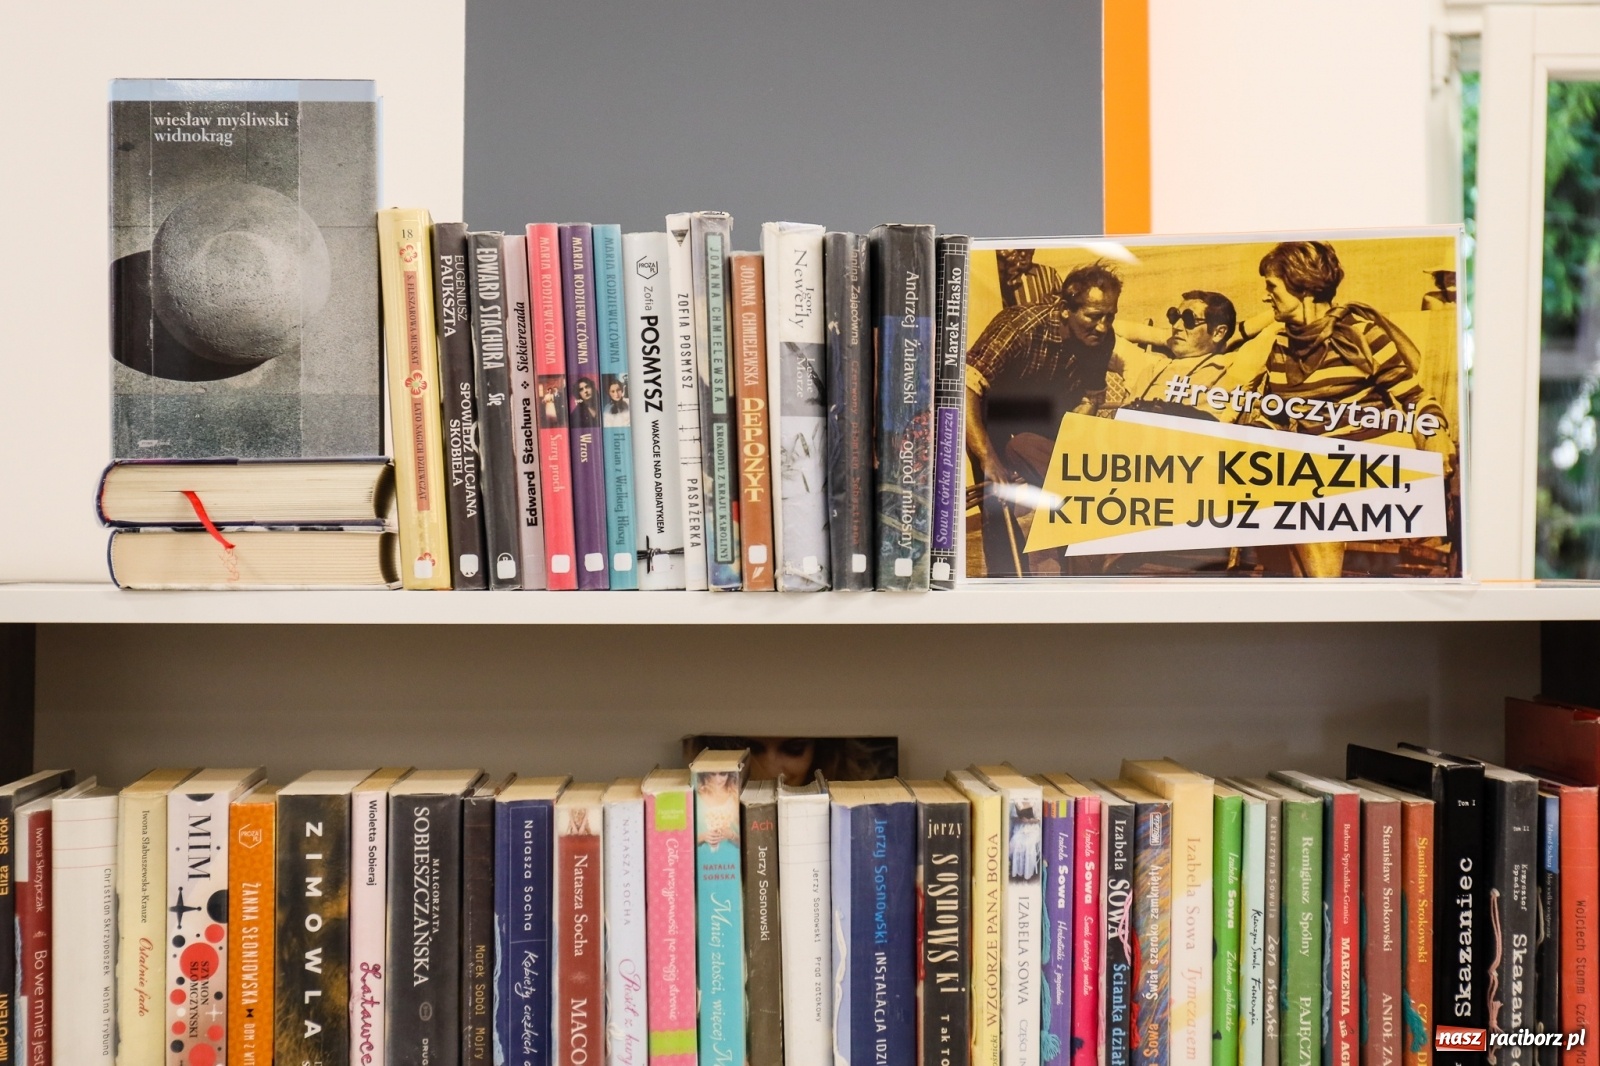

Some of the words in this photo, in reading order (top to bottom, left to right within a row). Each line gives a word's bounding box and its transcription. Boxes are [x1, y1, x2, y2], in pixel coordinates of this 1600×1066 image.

[154, 112, 212, 126] wiesław
[217, 112, 289, 131] myśliwski
[154, 128, 233, 147] widnokrąg
[475, 248, 503, 301] EDWARD
[539, 237, 552, 269] MARIA
[573, 237, 585, 269] MARIA
[605, 237, 616, 269] MARIA
[709, 247, 723, 299] JOANNA
[440, 255, 456, 337] PAUKSZTA
[454, 255, 467, 321] EUGENIUSZ
[643, 285, 655, 311] Zofia
[740, 264, 756, 307] JOANNA
[789, 250, 807, 328] Newerly
[803, 287, 815, 314] Igor
[902, 271, 920, 328] Andrzej
[947, 267, 962, 316] Hłasko
[407, 283, 419, 365] FLESZAROWA-MUSKAT
[541, 274, 557, 365] RODZIEWICZÓWNA
[575, 274, 589, 365] RODZIEWICZÓWNA
[606, 274, 620, 364] RODZIEWICZÓWNA
[678, 293, 690, 331] ZOFIA
[848, 285, 861, 346] Zającówna
[479, 305, 505, 369] STACHURA
[514, 301, 530, 373] Siekierezada
[711, 307, 726, 403] CHMIELEWSKA
[741, 312, 759, 386] CHMIELEWSKA
[945, 321, 959, 367] Marek
[640, 315, 663, 413] POSMYSZ
[679, 335, 693, 389] POSMYSZ
[796, 357, 807, 398] Morze
[806, 357, 816, 393] Leśne
[902, 338, 922, 404] Żuławski
[413, 403, 423, 421] LATO
[1165, 374, 1441, 436] #retroczytanie
[415, 424, 425, 454] NAGICH
[450, 420, 464, 486] SKOBIELA
[520, 398, 534, 465] Stachura
[579, 433, 592, 462] Wrzos
[613, 433, 625, 466] Florian
[650, 420, 660, 458] WAKACJE
[716, 425, 725, 472] KROKODYL
[741, 398, 766, 502] DEPOZYT
[940, 412, 954, 467] piekarza
[550, 464, 564, 492] proch
[653, 460, 661, 479] NAD
[898, 440, 916, 483] ogród
[1062, 453, 1204, 484] LUBIMY
[1218, 445, 1411, 498] KSIĄŻKI,
[464, 456, 477, 518] LUCJANA
[523, 471, 538, 527] Edward
[614, 475, 628, 512] Wielkiej
[654, 481, 664, 534] ADRIATYKIEM
[718, 483, 727, 510] KRAJU
[938, 471, 952, 507] córka
[615, 515, 629, 546] Hłuszy
[686, 478, 702, 547] PASAŻERKA
[897, 490, 916, 549] miłosny
[936, 510, 949, 544] Sowa
[1049, 489, 1174, 527] KTÓRE
[1186, 493, 1260, 530] JUŻ
[1274, 502, 1423, 533] ZNAMY
[719, 515, 728, 560] KAROLINY
[35, 827, 44, 857] Iwona
[141, 810, 150, 835] Iwona
[368, 800, 378, 842] Wioletta
[751, 820, 773, 831] Ach
[873, 818, 888, 857] Jerzy
[927, 819, 962, 839] jerzy
[1114, 819, 1127, 870] Izabela
[1343, 824, 1351, 852] Barbara
[188, 813, 212, 882] MIM
[366, 845, 378, 885] Sobieraj
[524, 820, 534, 879] Natasza
[622, 819, 630, 875] NATASZA
[665, 838, 679, 864] Cała
[757, 846, 768, 876] Jerzy
[986, 833, 999, 883] BOGA
[1058, 833, 1068, 861] Izabela
[1186, 838, 1201, 897] Izabela
[1227, 852, 1238, 884] Izabela
[1268, 816, 1277, 875] Katarzyna
[1382, 826, 1393, 883] Stanisław
[1418, 837, 1429, 895] Stanisław
[33, 860, 45, 912] Skrzypczak
[103, 868, 112, 915] Christian
[140, 837, 150, 923] Słabuszewska-Krauze
[573, 854, 588, 910] Natasza
[812, 868, 820, 893] Jerzy
[1058, 865, 1068, 908] Sowa
[1084, 861, 1095, 904] Sowa
[1149, 865, 1163, 919] zamknięty
[1298, 837, 1315, 904] Remigiusz
[1341, 853, 1351, 924] Spychalska-Granica
[1519, 864, 1528, 912] Krzysztof
[241, 882, 261, 921] ŻANNA
[413, 807, 432, 987] SOBIESZCZAŃSKA
[432, 859, 440, 934] MAŁGORZATA
[524, 886, 533, 931] Socha
[623, 883, 631, 926] SOCHA
[661, 867, 681, 935] przyjemność
[710, 893, 732, 947] Mniej
[759, 880, 770, 941] Sosnowski
[812, 897, 822, 943] Sosnowski
[874, 865, 888, 945] Sosnowski
[986, 889, 998, 936] PANA
[1227, 889, 1237, 928] Sowa
[1269, 879, 1277, 919] Sowula
[1383, 888, 1393, 951] Srokowski
[304, 821, 323, 1039] ZIMOWLA
[574, 914, 588, 956] Socha
[1018, 897, 1030, 955] IZABELA
[1056, 921, 1068, 961] Herbatniki
[1149, 924, 1159, 964] szeroko
[1186, 906, 1200, 950] Sowa
[1297, 912, 1315, 957] Spólny
[1416, 899, 1427, 963] Srokowski
[1454, 857, 1472, 1017] Skazaniec
[1575, 900, 1587, 950] Wojciech
[34, 950, 47, 970] Bo
[34, 972, 43, 995] we
[137, 938, 153, 987] Ostatnie
[198, 960, 210, 1006] SZYMON
[241, 927, 259, 1005] SŁONIOWSKA
[475, 945, 485, 977] Marek
[515, 950, 538, 998] Kobiety
[985, 940, 998, 1027] WZGÓRZE
[1017, 961, 1030, 1005] SOWA
[1226, 951, 1237, 985] Zielone
[1340, 938, 1351, 1016] MARZENIA
[1576, 957, 1587, 994] Stamm
[133, 989, 148, 1017] fado
[188, 961, 199, 1038] SŁOMCZYŃSKI
[475, 984, 486, 1015] Soból
[874, 951, 888, 1033] INSTALACJA
[1112, 964, 1130, 1022] Ścianka
[1140, 969, 1159, 1000] Świat
[33, 1000, 46, 1036] mnie
[360, 962, 382, 1066] Latawce
[521, 1005, 538, 1054] ciężkich
[709, 1000, 725, 1040] więcej
[1182, 967, 1203, 1060] Tymczasem
[1224, 986, 1236, 1033] jabłuszko
[1382, 992, 1393, 1042] ANIOŁ
[101, 1018, 111, 1056] Trybuna
[473, 1027, 486, 1059] Mojry
[1143, 1023, 1159, 1057] Sowa
